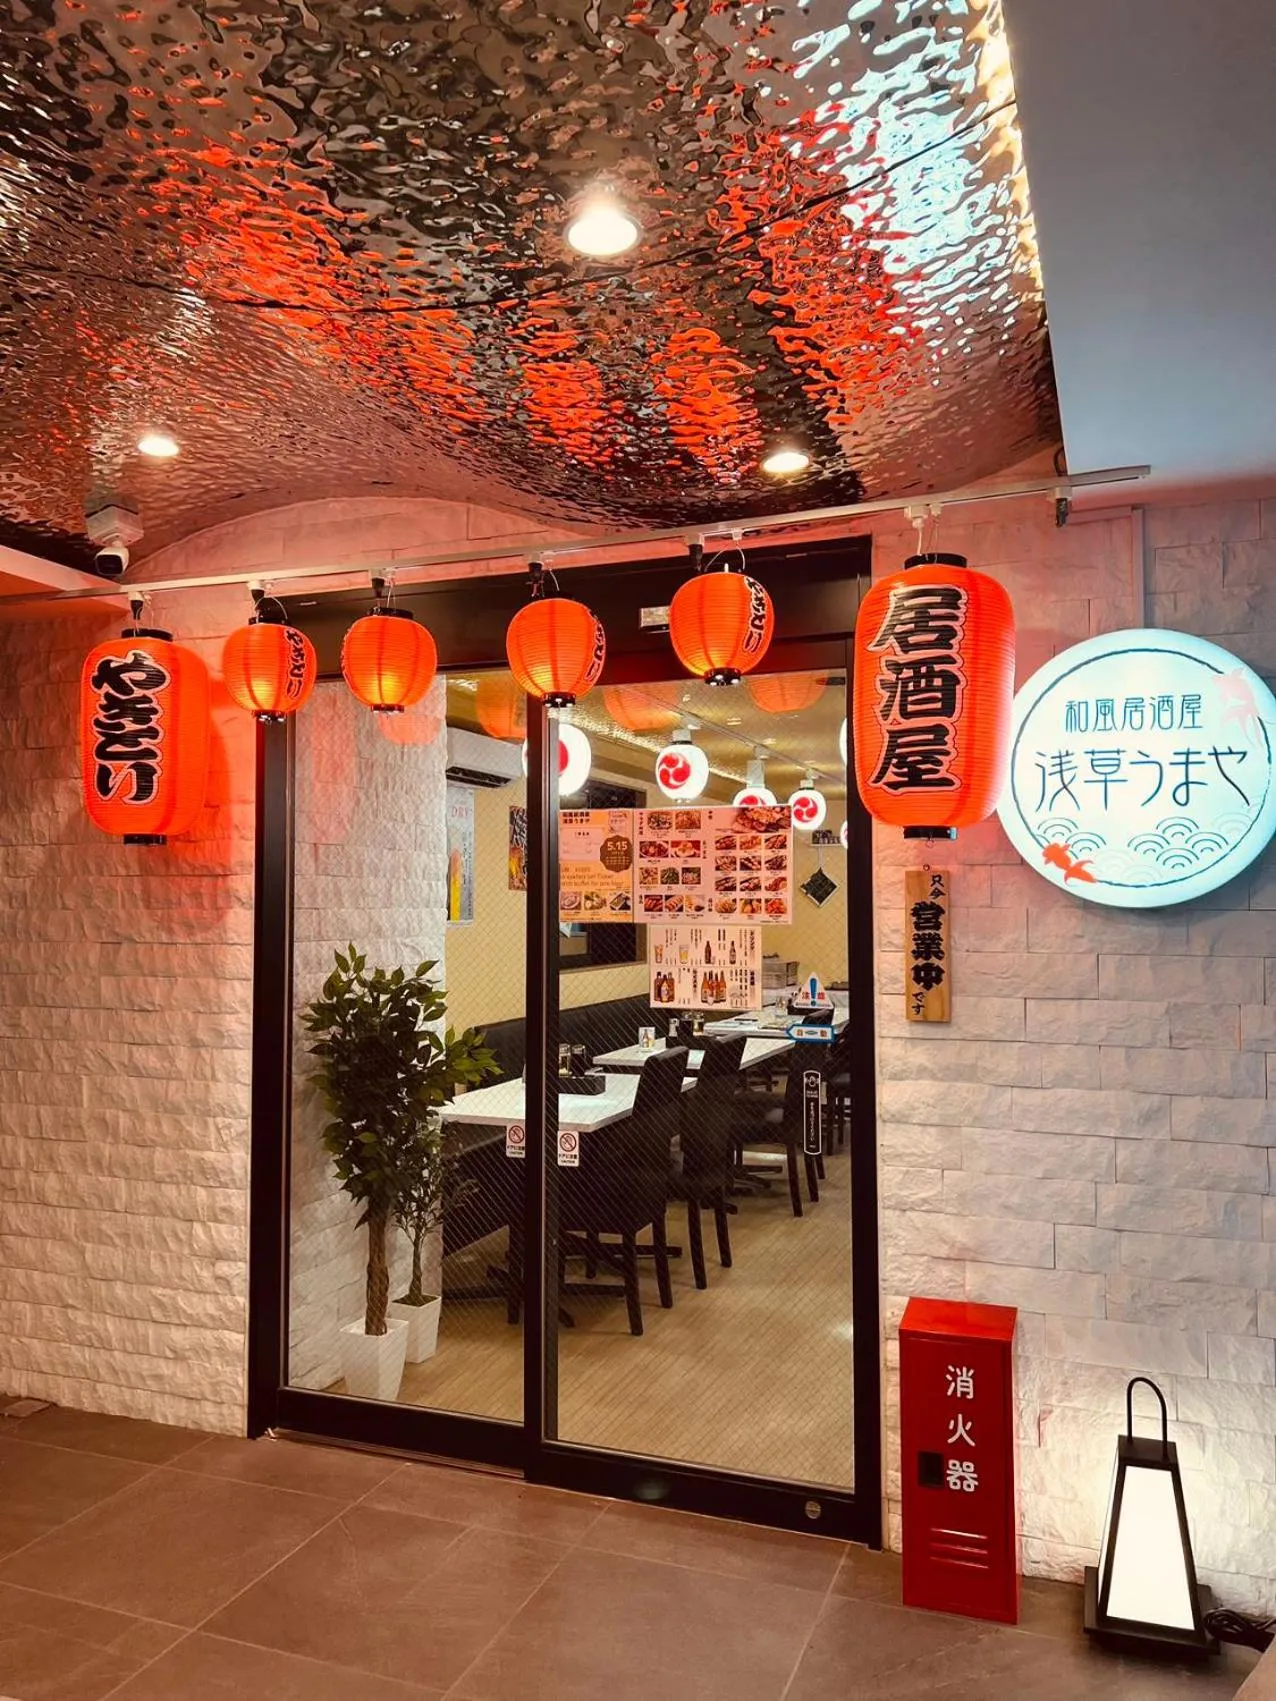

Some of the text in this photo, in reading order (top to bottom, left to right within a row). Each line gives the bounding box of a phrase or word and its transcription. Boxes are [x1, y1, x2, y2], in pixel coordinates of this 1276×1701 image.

[285, 629, 306, 698] やきとり
[870, 586, 966, 791] 居酒屋
[91, 652, 168, 803] やきとり
[1064, 694, 1203, 733] 和風居酒屋
[1034, 745, 1252, 812] 浅草うまや
[945, 1364, 979, 1493] 消火器
